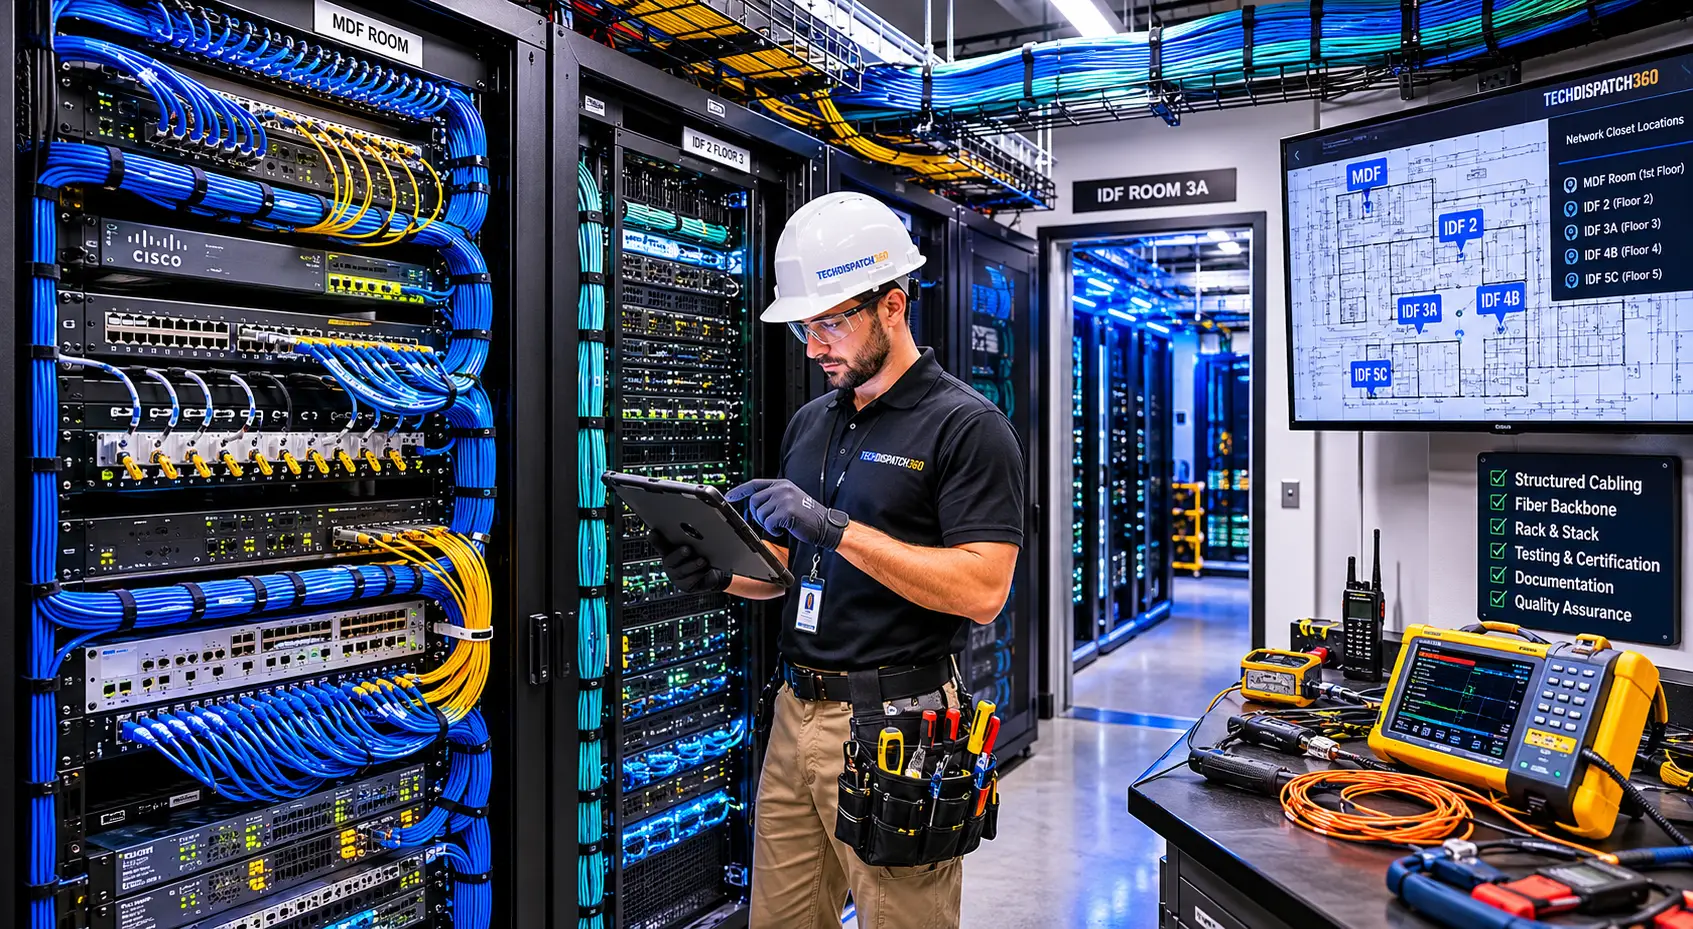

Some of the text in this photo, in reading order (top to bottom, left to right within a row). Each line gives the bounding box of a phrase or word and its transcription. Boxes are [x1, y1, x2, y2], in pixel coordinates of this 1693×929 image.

[333, 13, 408, 54] MDF ROOM
[1543, 69, 1659, 107] TECHDISPATCH360
[1566, 116, 1685, 145] Network Closet Locations
[692, 135, 744, 165] IDF 2 FLOOR 3
[1352, 165, 1381, 185] MDF
[1583, 162, 1685, 188] MDF Room (1st Floor)
[1097, 180, 1209, 203] IDF ROOM 3A
[1584, 193, 1654, 213] IDF 2 (Floor 2)
[1444, 217, 1478, 236] IDF 2
[1584, 217, 1661, 237] IDF 3A (Floor 3)
[133, 250, 182, 268] CISCO
[1584, 242, 1662, 261] IDF 4B (Floor 4)
[1585, 268, 1663, 285] IDF 5C (Floor 5)
[1481, 290, 1520, 308] IDF 4B
[1402, 302, 1438, 318] IDF 3A
[1354, 367, 1388, 382] IDF 5C
[1515, 472, 1643, 495] Structured Cabling
[1515, 497, 1617, 517] Fiber Backbone
[1515, 521, 1600, 541] Rack & Stack
[1515, 545, 1661, 573] Testing & Certification
[1515, 570, 1614, 594] Documentation
[1515, 594, 1632, 622] Quality Assurance
